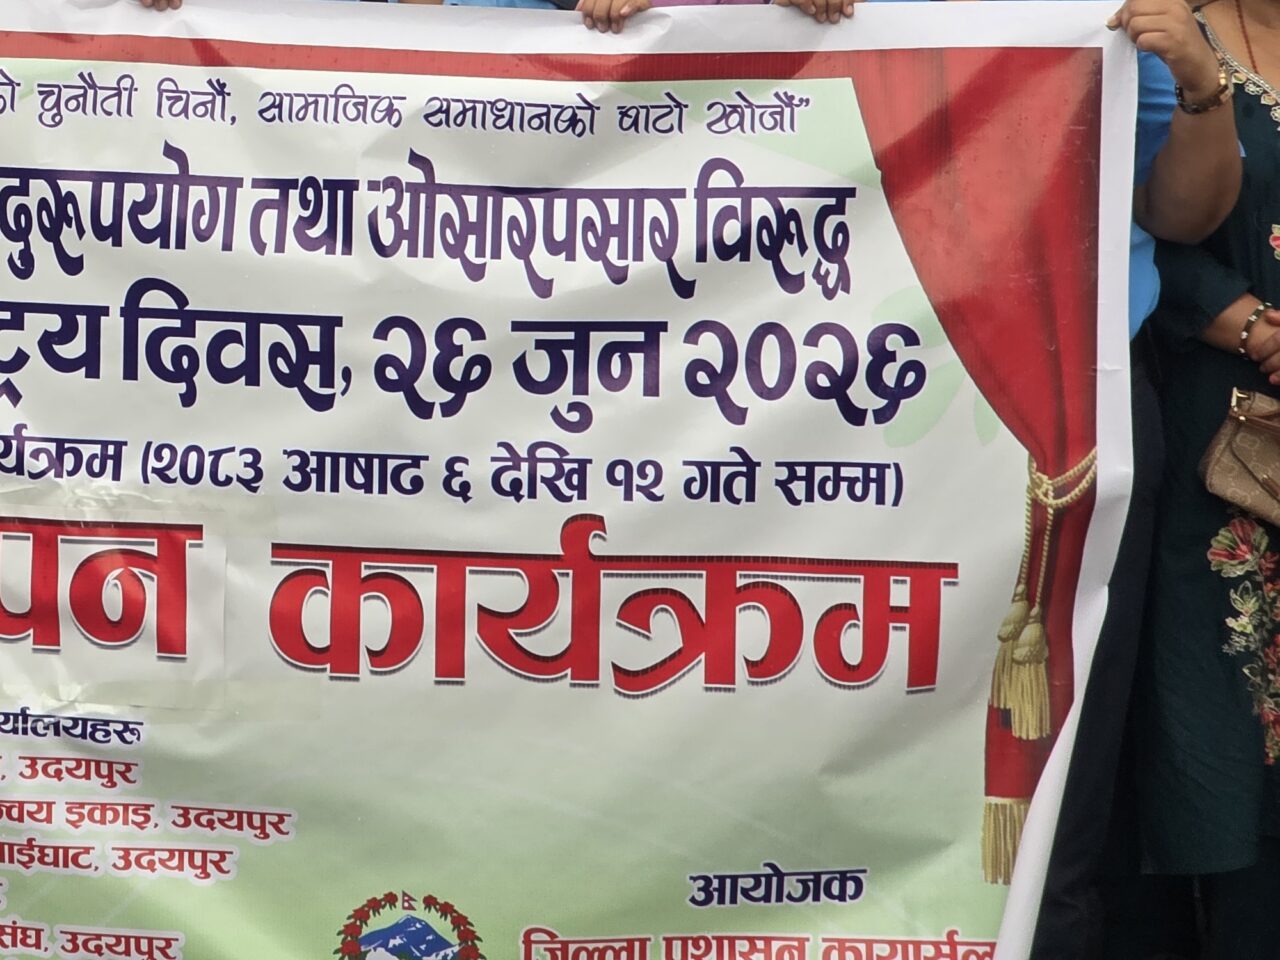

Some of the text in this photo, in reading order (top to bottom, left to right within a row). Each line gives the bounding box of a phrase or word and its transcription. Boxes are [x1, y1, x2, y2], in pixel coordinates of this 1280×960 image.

[37, 70, 139, 128] चुनौती
[257, 84, 407, 130] सामाजिक
[422, 93, 602, 137] समाधानको
[617, 90, 690, 136] बाटो
[251, 176, 359, 257] तथा
[366, 146, 697, 300] ओसारपसार
[120, 277, 353, 413] दिवस,
[373, 315, 494, 421] २६
[511, 319, 669, 434] जुन
[682, 318, 929, 427] २०२६
[140, 439, 265, 496] (२०८३
[282, 447, 430, 496] आषाढ
[442, 454, 472, 504] ६
[490, 440, 593, 505] देखि
[605, 457, 665, 503] १२
[682, 446, 762, 505] गते
[774, 459, 904, 508] सम्म)
[268, 513, 959, 697] कार्यक्रम
[18, 756, 139, 789] उदयपुर
[170, 805, 292, 840] उदयपुर
[111, 846, 234, 880] उदयपुर
[688, 863, 867, 906] आयोजक
